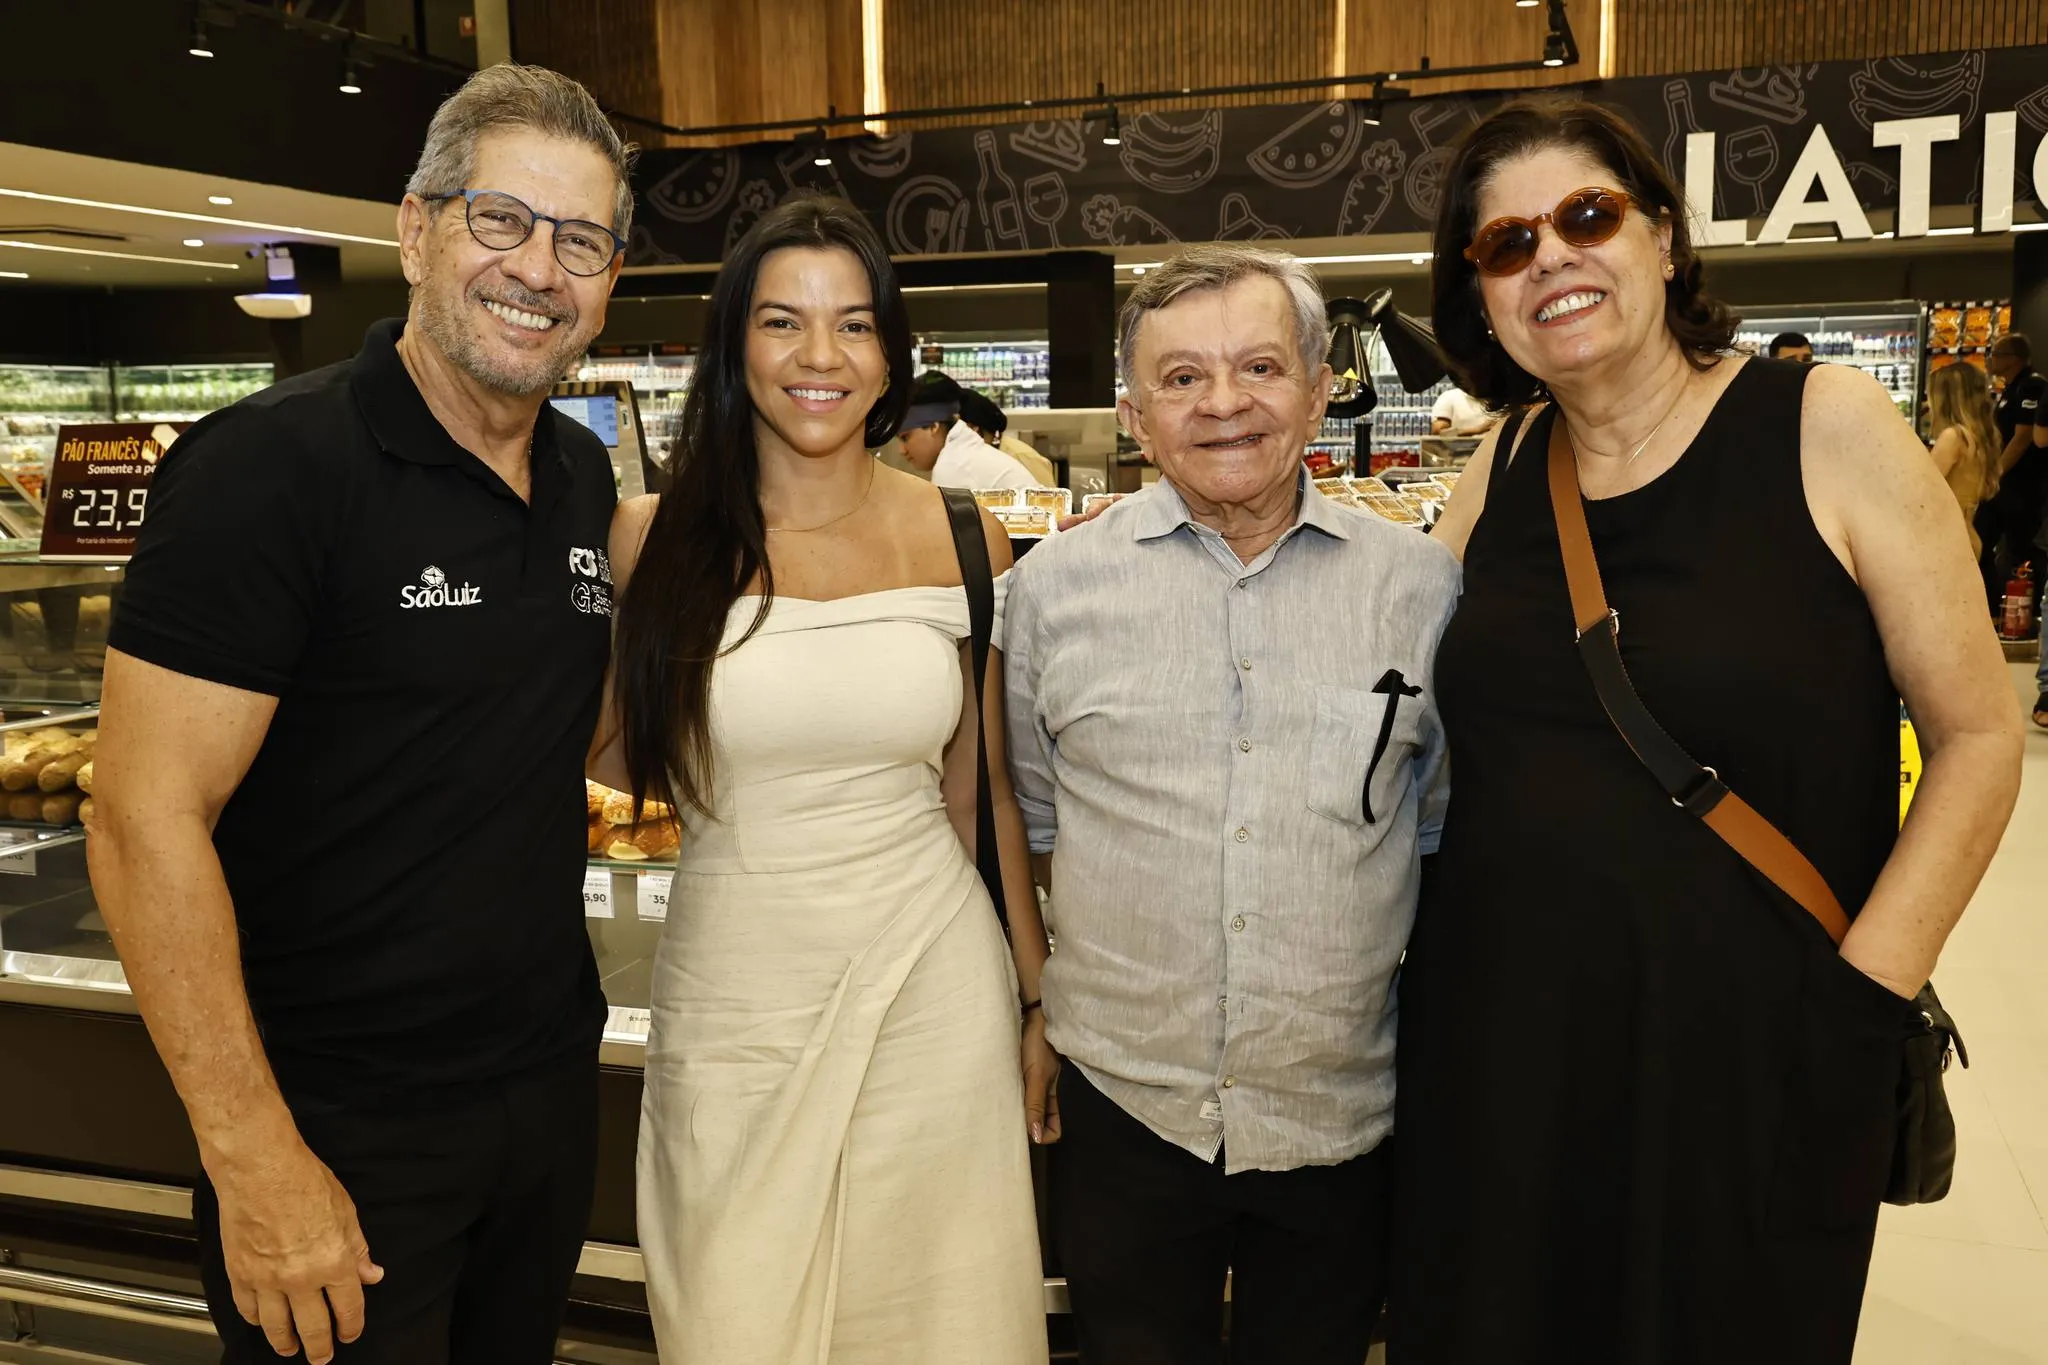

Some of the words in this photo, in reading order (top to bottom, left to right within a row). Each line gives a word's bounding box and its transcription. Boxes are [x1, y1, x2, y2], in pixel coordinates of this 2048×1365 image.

[1684, 110, 2048, 248] LATI
[61, 437, 85, 461] PÃO
[86, 436, 139, 461] FRANCÊS
[87, 463, 133, 475] Somente
[134, 465, 142, 474] a
[62, 488, 75, 500] R$
